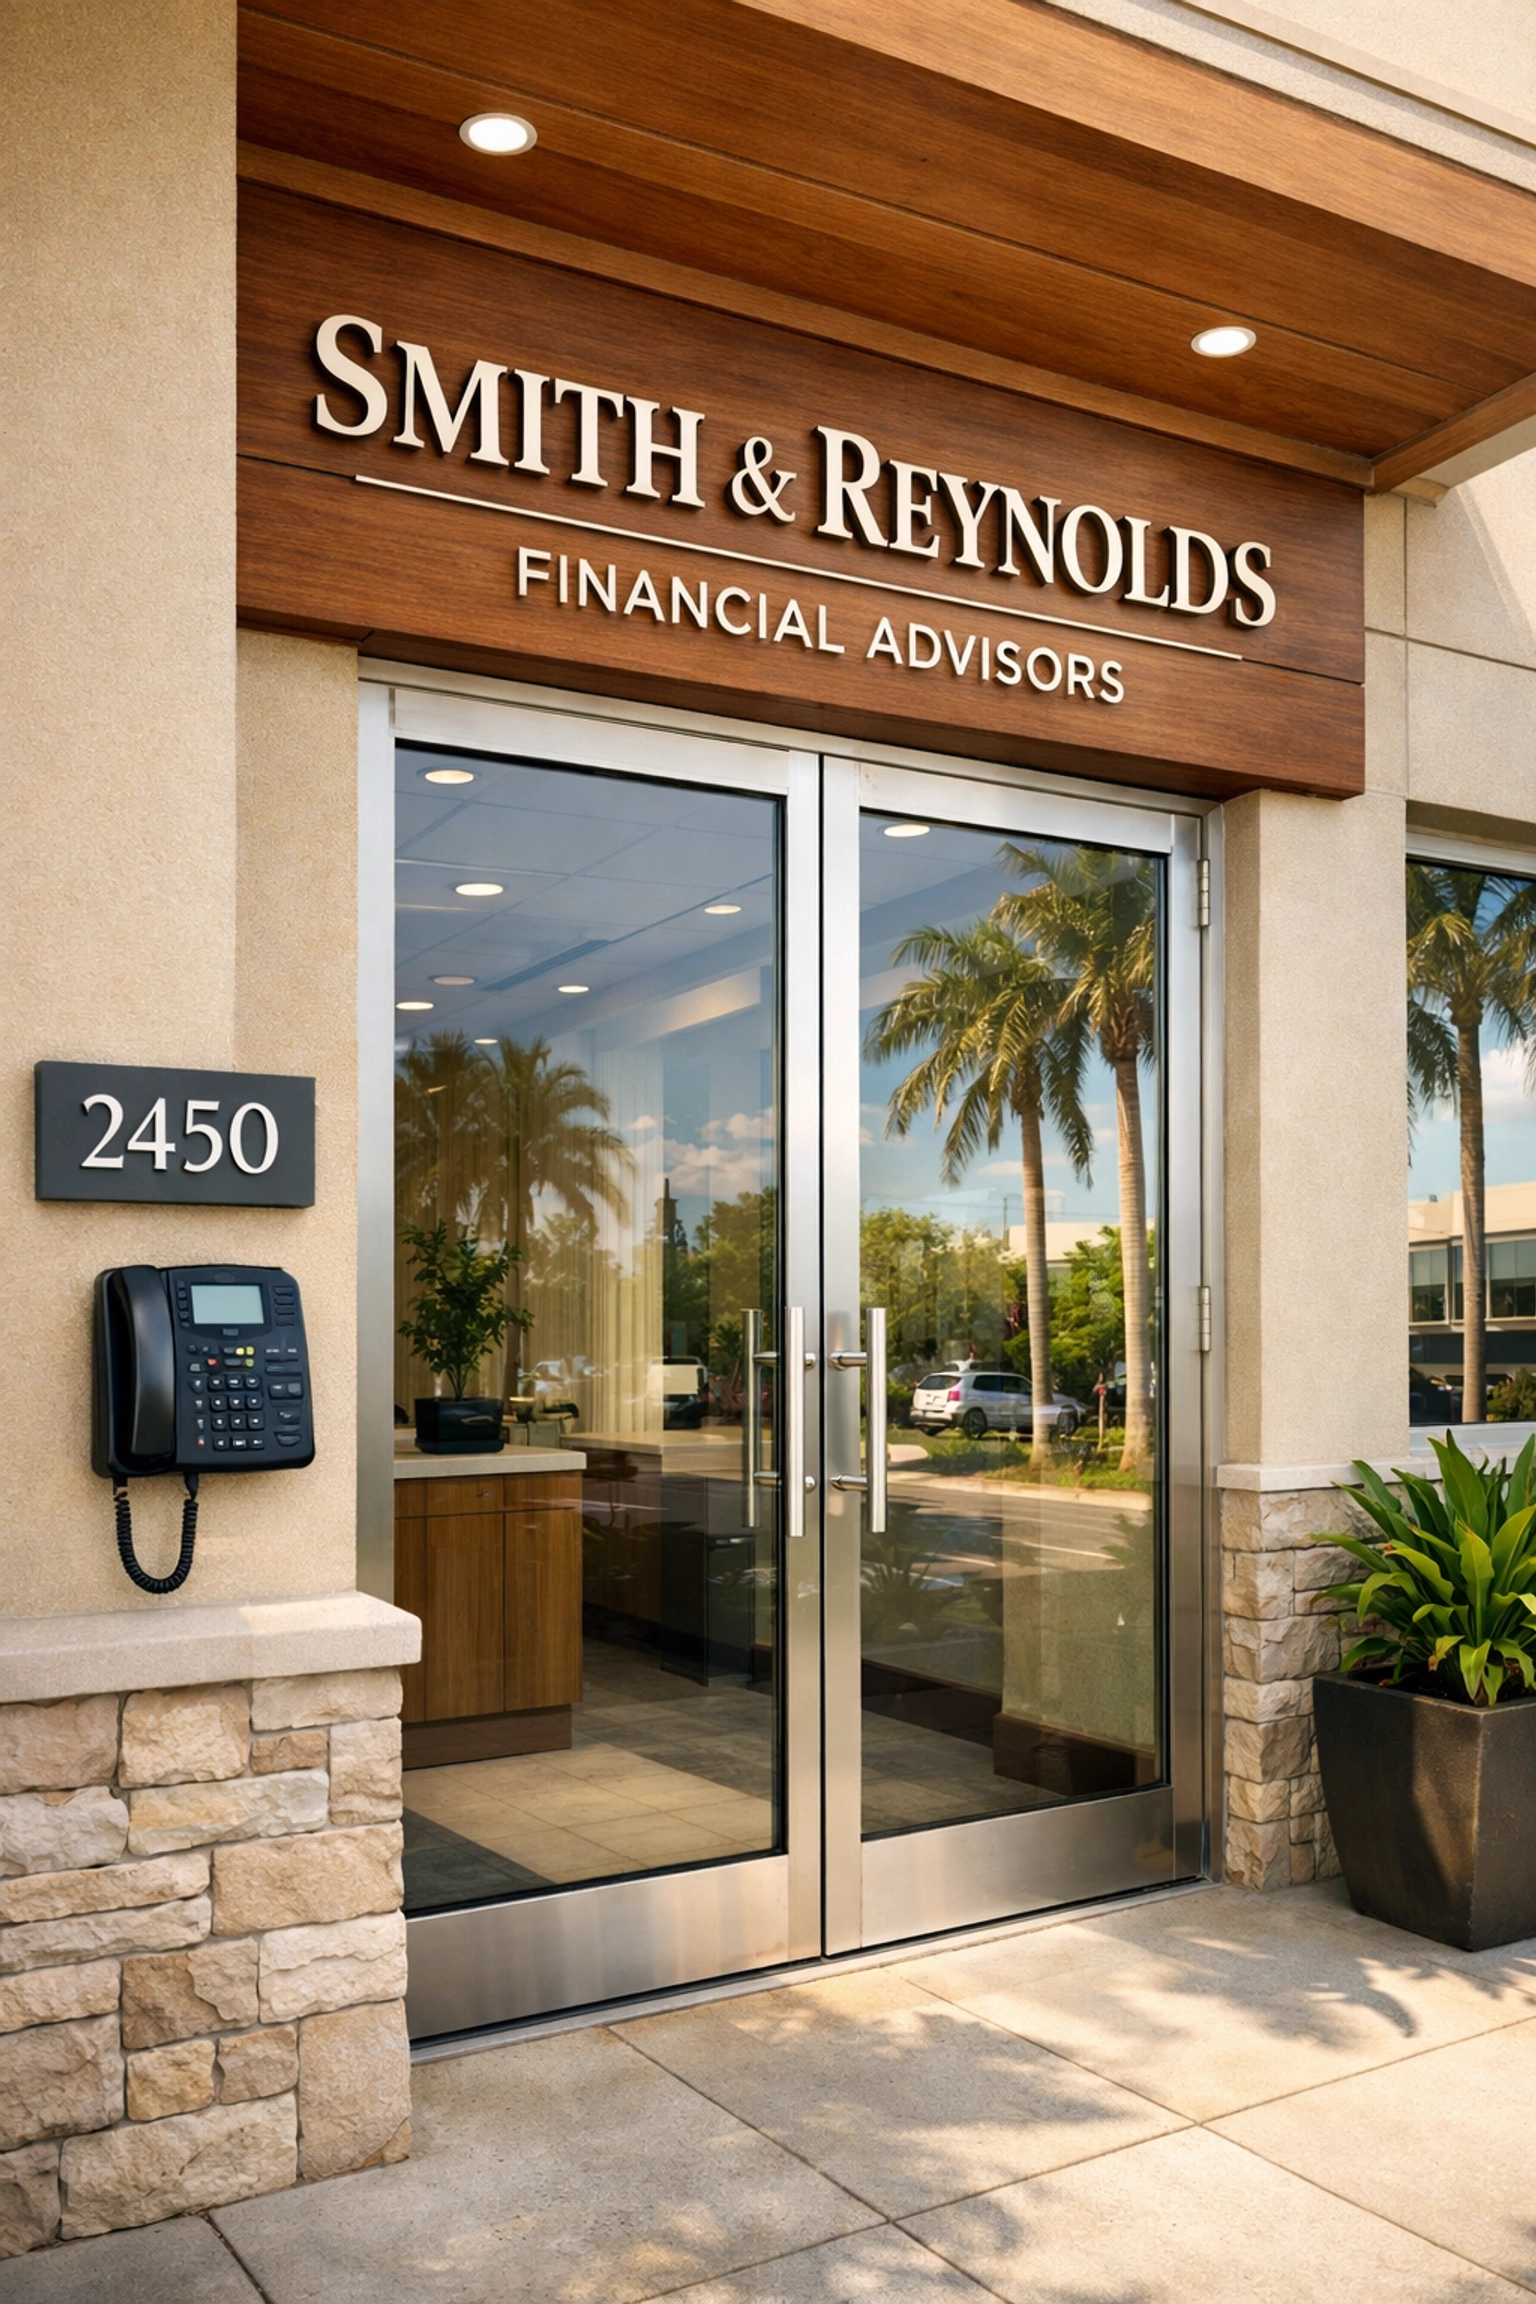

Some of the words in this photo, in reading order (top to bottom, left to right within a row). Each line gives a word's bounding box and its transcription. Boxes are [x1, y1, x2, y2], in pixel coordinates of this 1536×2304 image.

[315, 314, 706, 510] SMITH
[728, 435, 797, 524] &
[815, 425, 1277, 629] REYNOLDS
[517, 546, 845, 654] FINANCIAL
[867, 617, 1126, 705] ADVISORS
[80, 1093, 280, 1175] 2450
